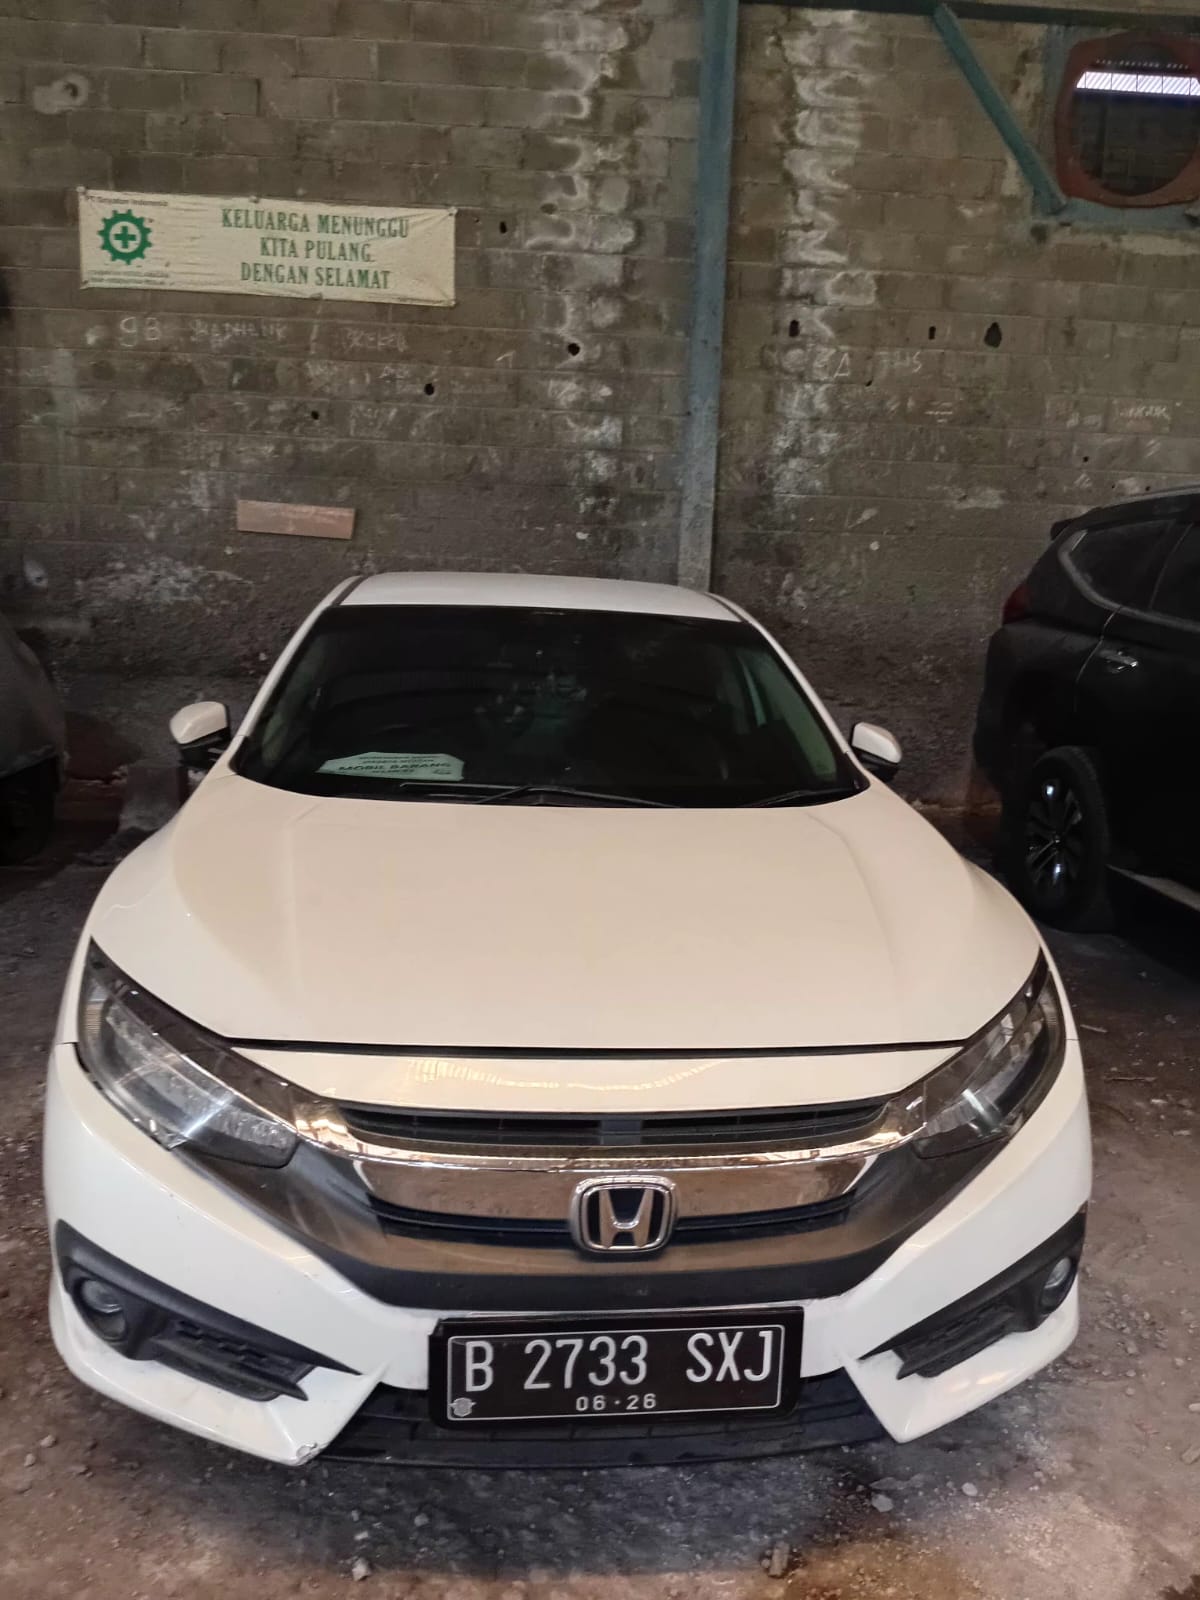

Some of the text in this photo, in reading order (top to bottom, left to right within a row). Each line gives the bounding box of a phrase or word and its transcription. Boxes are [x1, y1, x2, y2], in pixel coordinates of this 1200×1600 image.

[221, 208, 410, 238] KELUARGA MENUNGGU
[260, 237, 299, 258] KITA
[240, 262, 391, 289] DENGAN SELAMAT
[465, 1330, 774, 1393] B 2733 SXJ
